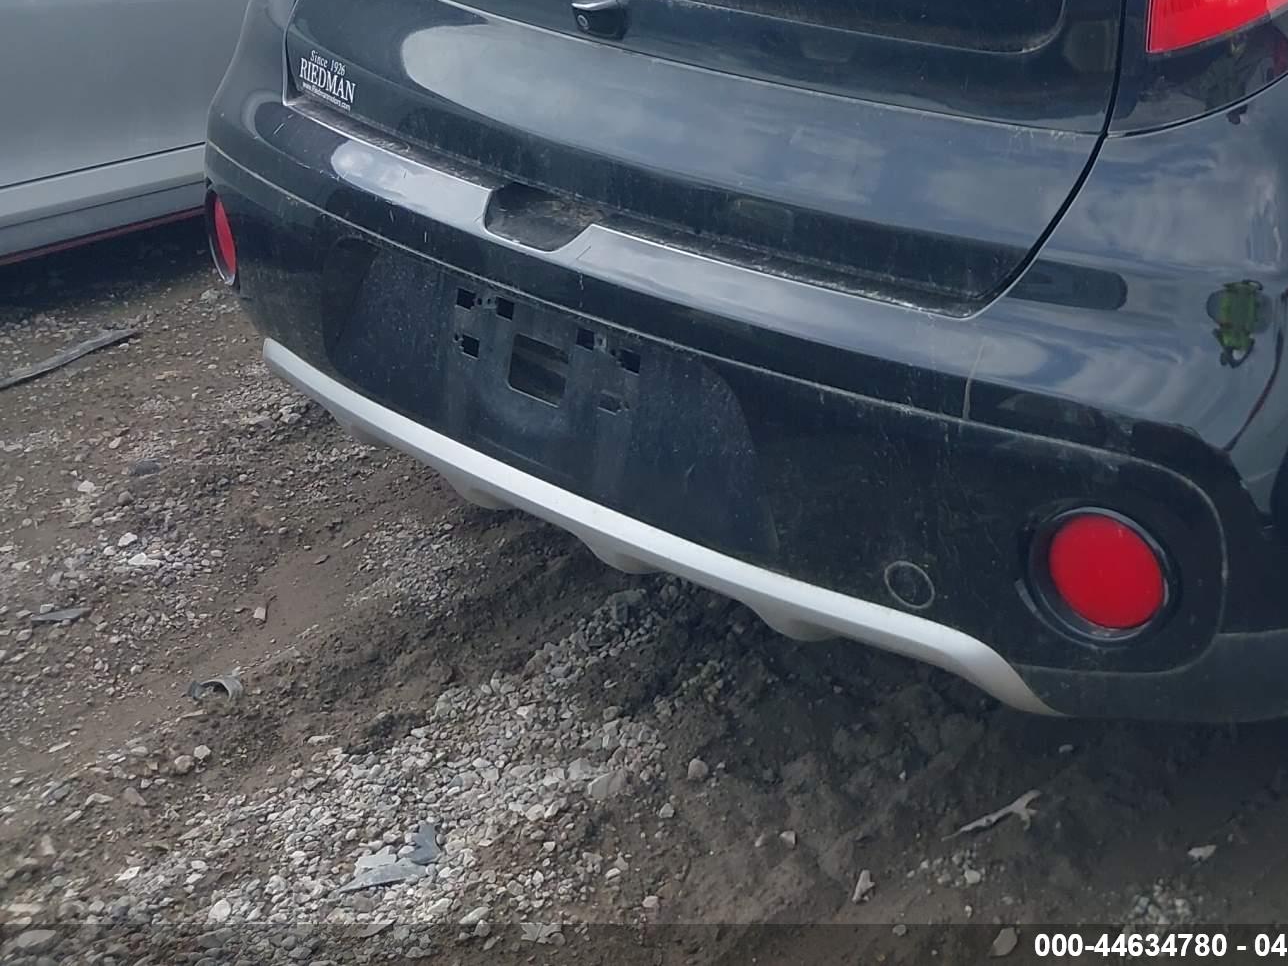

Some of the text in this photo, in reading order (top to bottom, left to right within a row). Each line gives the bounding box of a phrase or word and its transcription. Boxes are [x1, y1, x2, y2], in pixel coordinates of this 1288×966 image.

[299, 57, 357, 104] RIEDMAN
[310, 49, 346, 76] Since 1926
